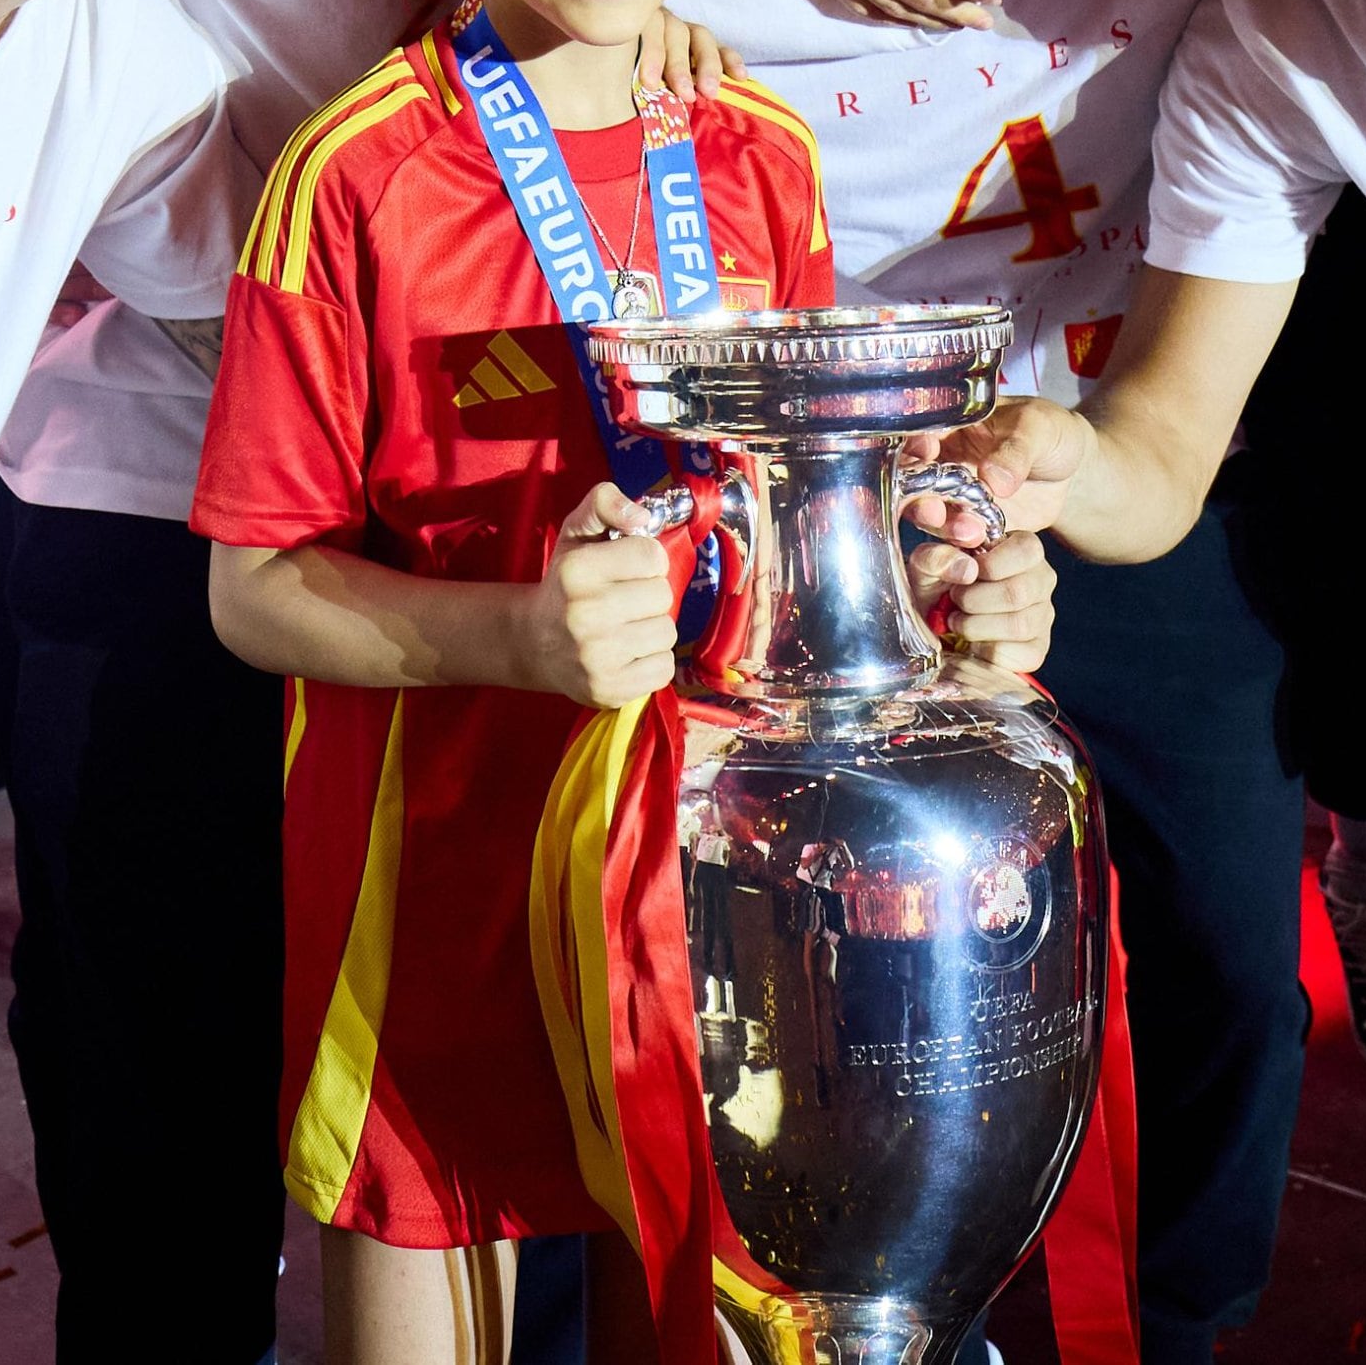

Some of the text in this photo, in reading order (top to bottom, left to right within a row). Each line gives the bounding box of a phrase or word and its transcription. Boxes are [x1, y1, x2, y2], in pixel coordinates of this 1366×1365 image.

[835, 18, 1134, 118] REYES
[940, 112, 1100, 265] 4
[661, 171, 709, 308] UEFA
[848, 1028, 1003, 1068] EUROPEAN
[970, 990, 1036, 1023] UEFA
